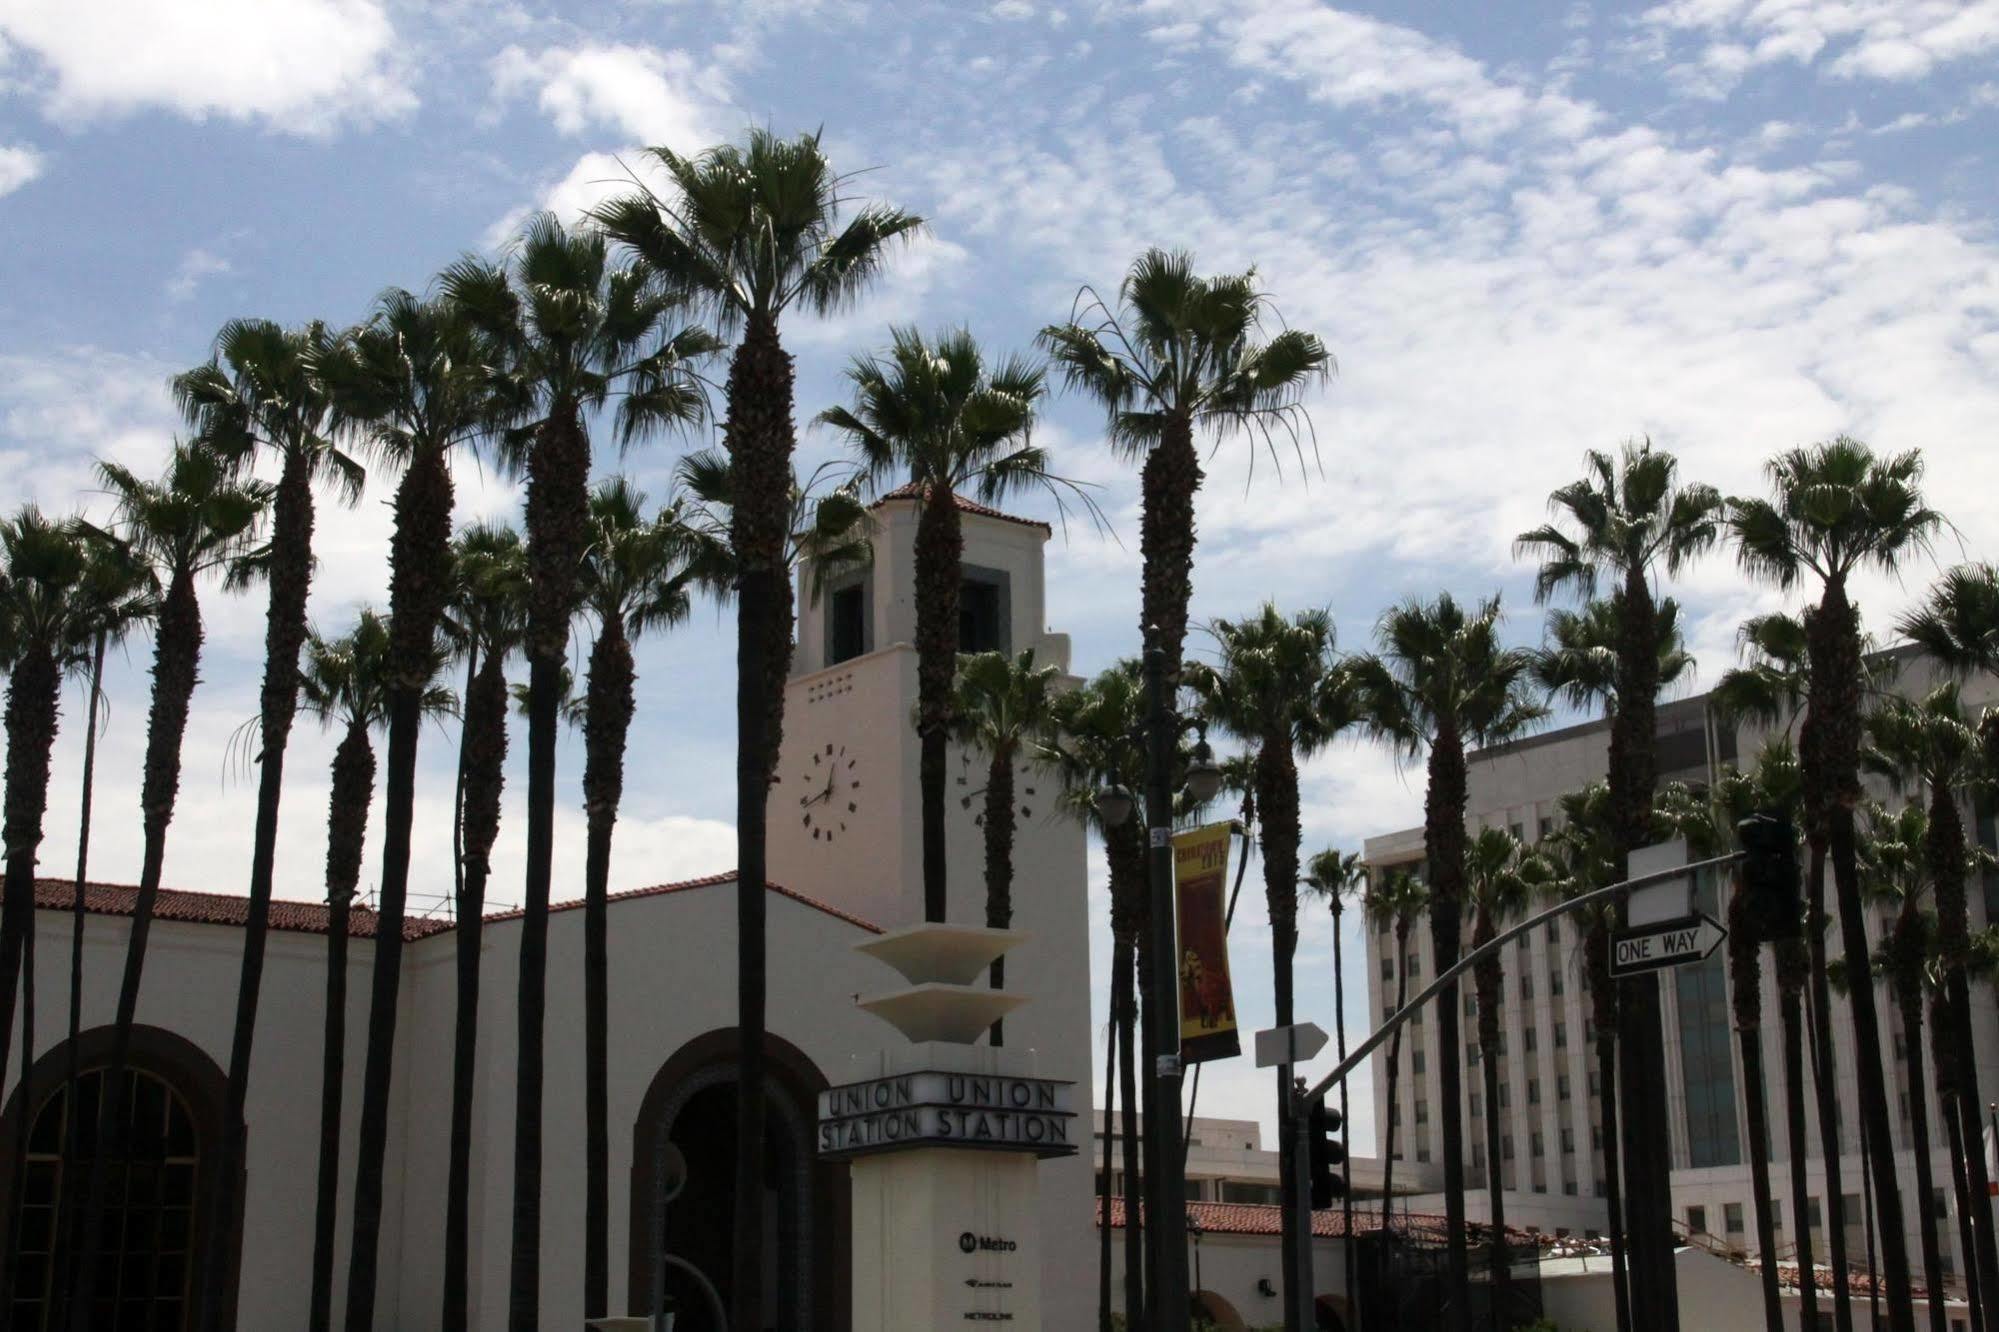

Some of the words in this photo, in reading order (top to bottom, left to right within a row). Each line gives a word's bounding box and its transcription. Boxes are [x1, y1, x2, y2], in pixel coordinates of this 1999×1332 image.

[1618, 939, 1651, 963] ONE
[1663, 929, 1698, 953] WAY
[828, 1078, 913, 1117] UNION
[949, 1074, 1056, 1109] UNION
[821, 1110, 920, 1150] STATION
[936, 1109, 1068, 1143] STATION
[979, 1236, 1017, 1252] Metro
